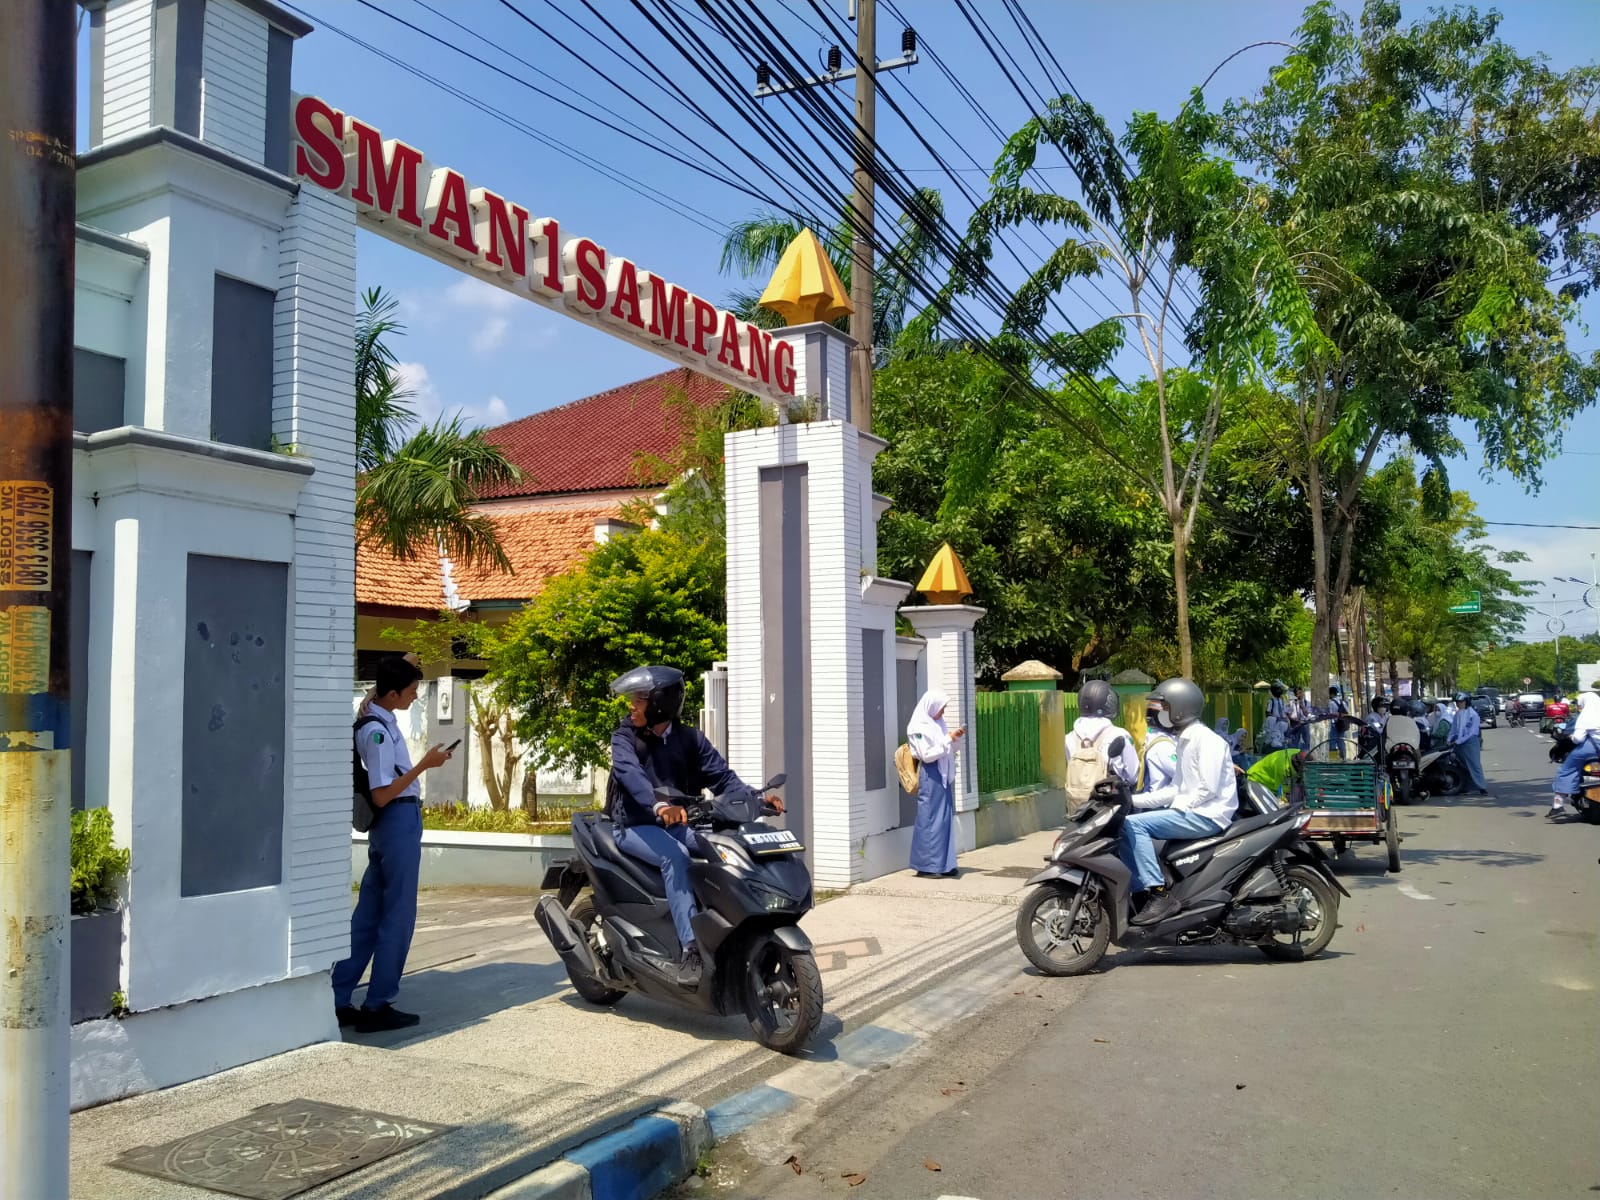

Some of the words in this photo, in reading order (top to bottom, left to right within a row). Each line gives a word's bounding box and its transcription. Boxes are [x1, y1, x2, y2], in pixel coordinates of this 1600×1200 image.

[294, 96, 530, 276] SMAN
[539, 217, 565, 295] 1
[575, 237, 798, 397] SAMPANG
[0, 485, 14, 511] WC
[16, 486, 51, 517] 7979
[0, 515, 13, 569] SEDOT
[15, 520, 50, 551] 3536
[15, 555, 49, 586] 0813
[0, 642, 11, 693] SEDOT
